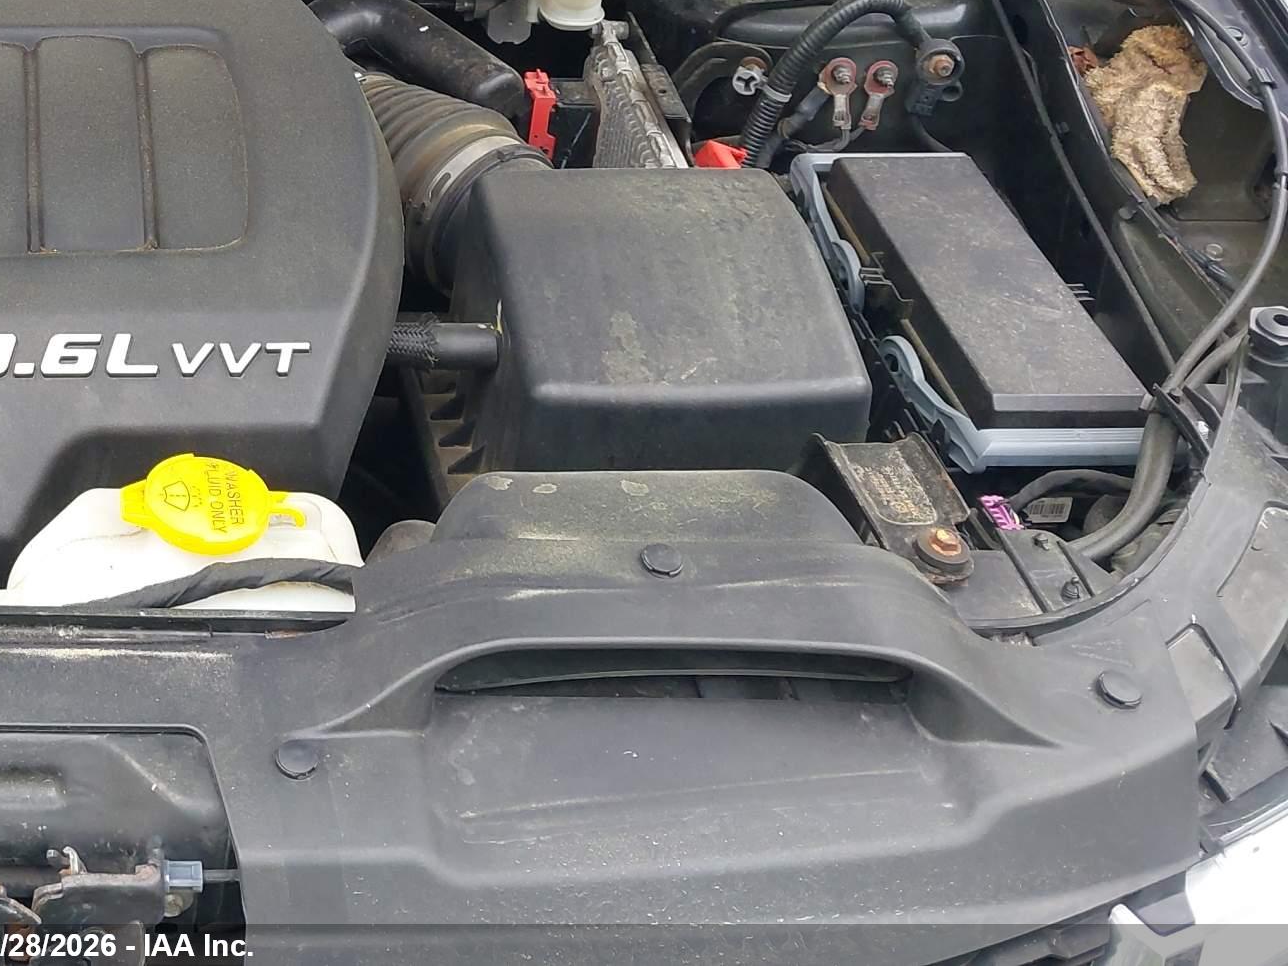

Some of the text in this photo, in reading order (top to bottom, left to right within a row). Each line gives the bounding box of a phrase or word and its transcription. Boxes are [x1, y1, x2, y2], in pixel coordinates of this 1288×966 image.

[171, 341, 311, 377] VVT
[206, 463, 227, 533] FLUID ONLY
[224, 471, 244, 525] WASHER
